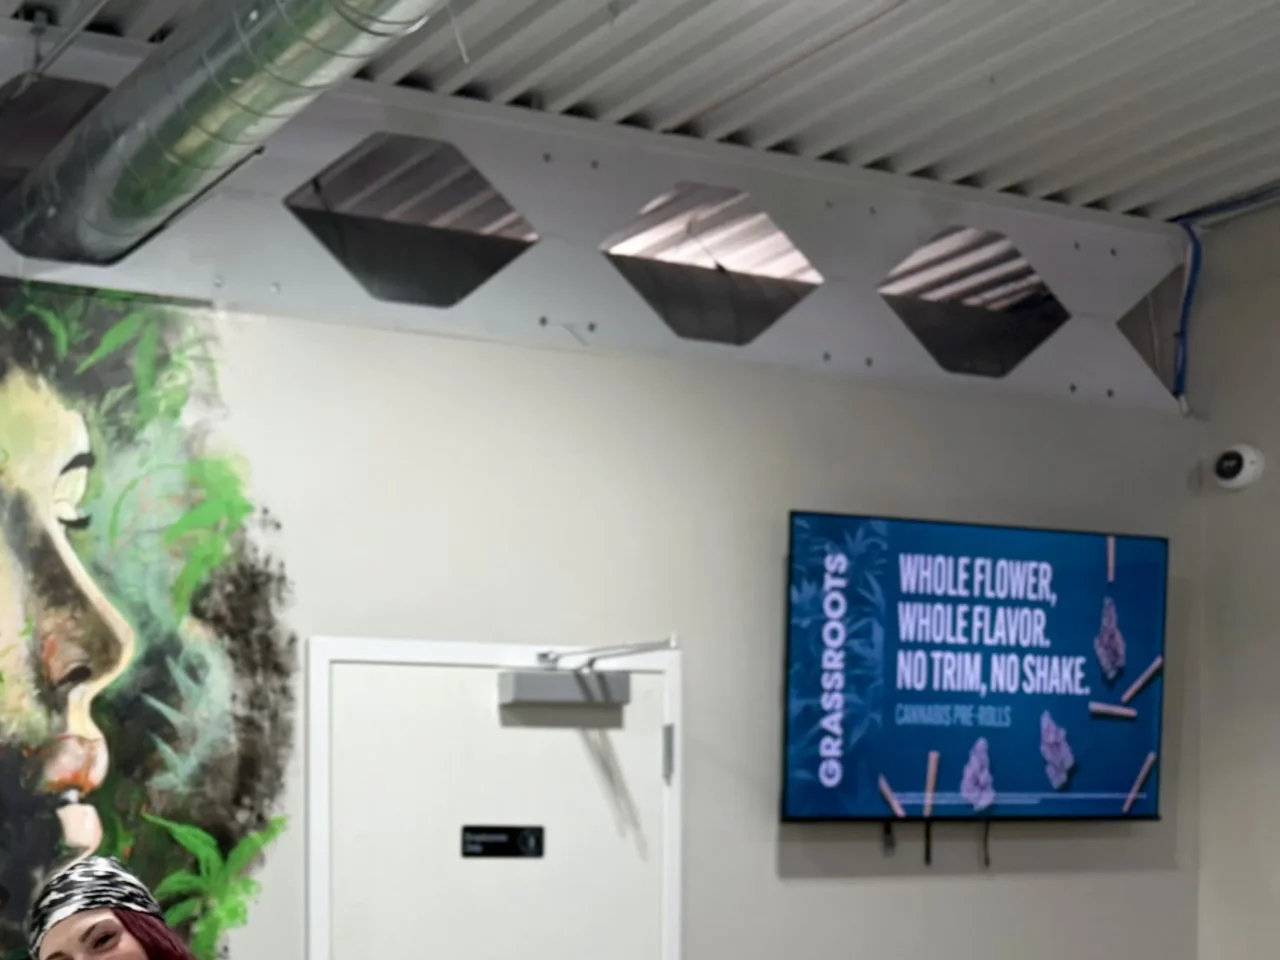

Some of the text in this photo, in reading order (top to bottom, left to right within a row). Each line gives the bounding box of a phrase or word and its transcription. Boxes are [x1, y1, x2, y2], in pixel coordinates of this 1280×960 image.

[899, 553, 1058, 608] WHOLE FLOWER,
[897, 601, 1051, 648] WHOLE FLAVOR.
[818, 551, 848, 788] GRASSROOTS
[896, 649, 1091, 698] NO TRIM, NO SHAKE.
[895, 703, 951, 726] CANNABIS
